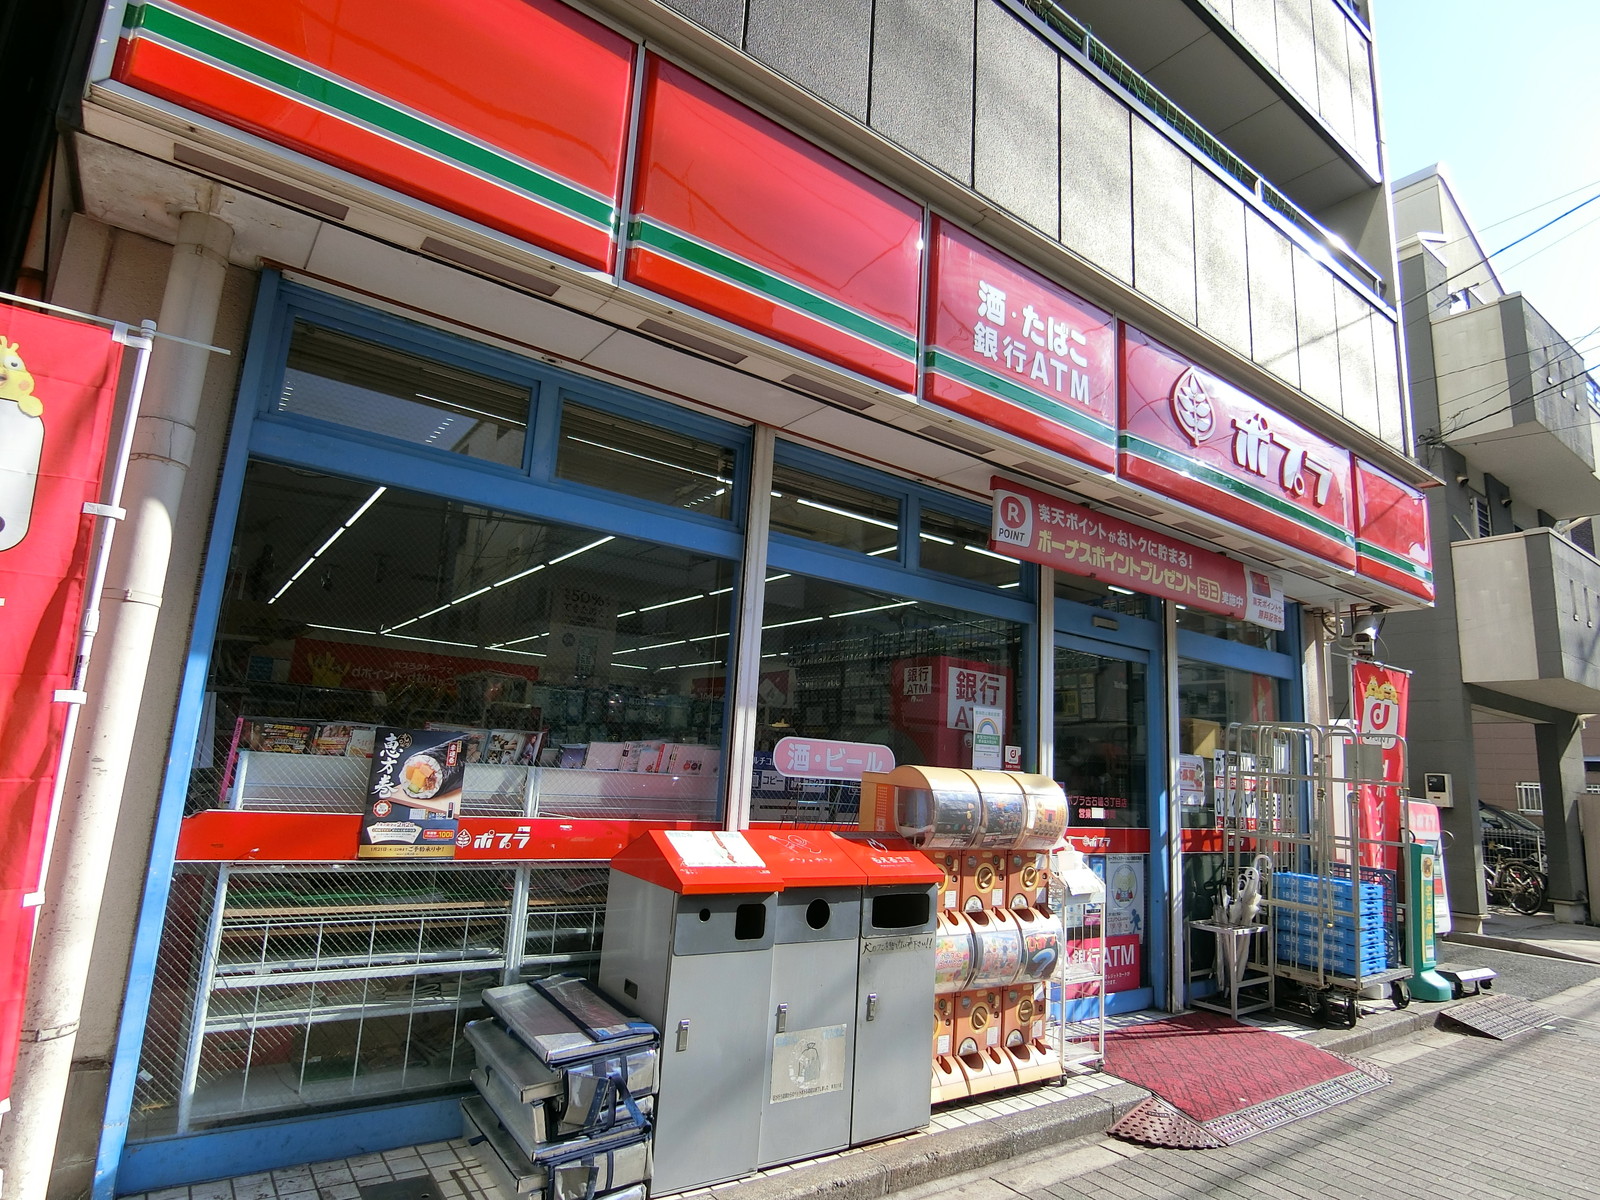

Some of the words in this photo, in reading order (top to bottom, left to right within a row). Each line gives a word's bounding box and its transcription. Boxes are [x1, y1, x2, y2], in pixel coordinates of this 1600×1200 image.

[978, 280, 1088, 368] 酒・たばこ
[974, 321, 1090, 405] 銀行ATM
[1230, 413, 1333, 508] ポプラ
[1007, 502, 1020, 523] R
[998, 527, 1026, 542] POINT
[906, 683, 928, 695] ATM
[907, 667, 929, 682] 銀行
[955, 670, 1000, 706] 銀行
[370, 732, 404, 798] 恵方巻
[787, 742, 883, 772] 酒・ビール
[473, 827, 531, 849] ポプラ
